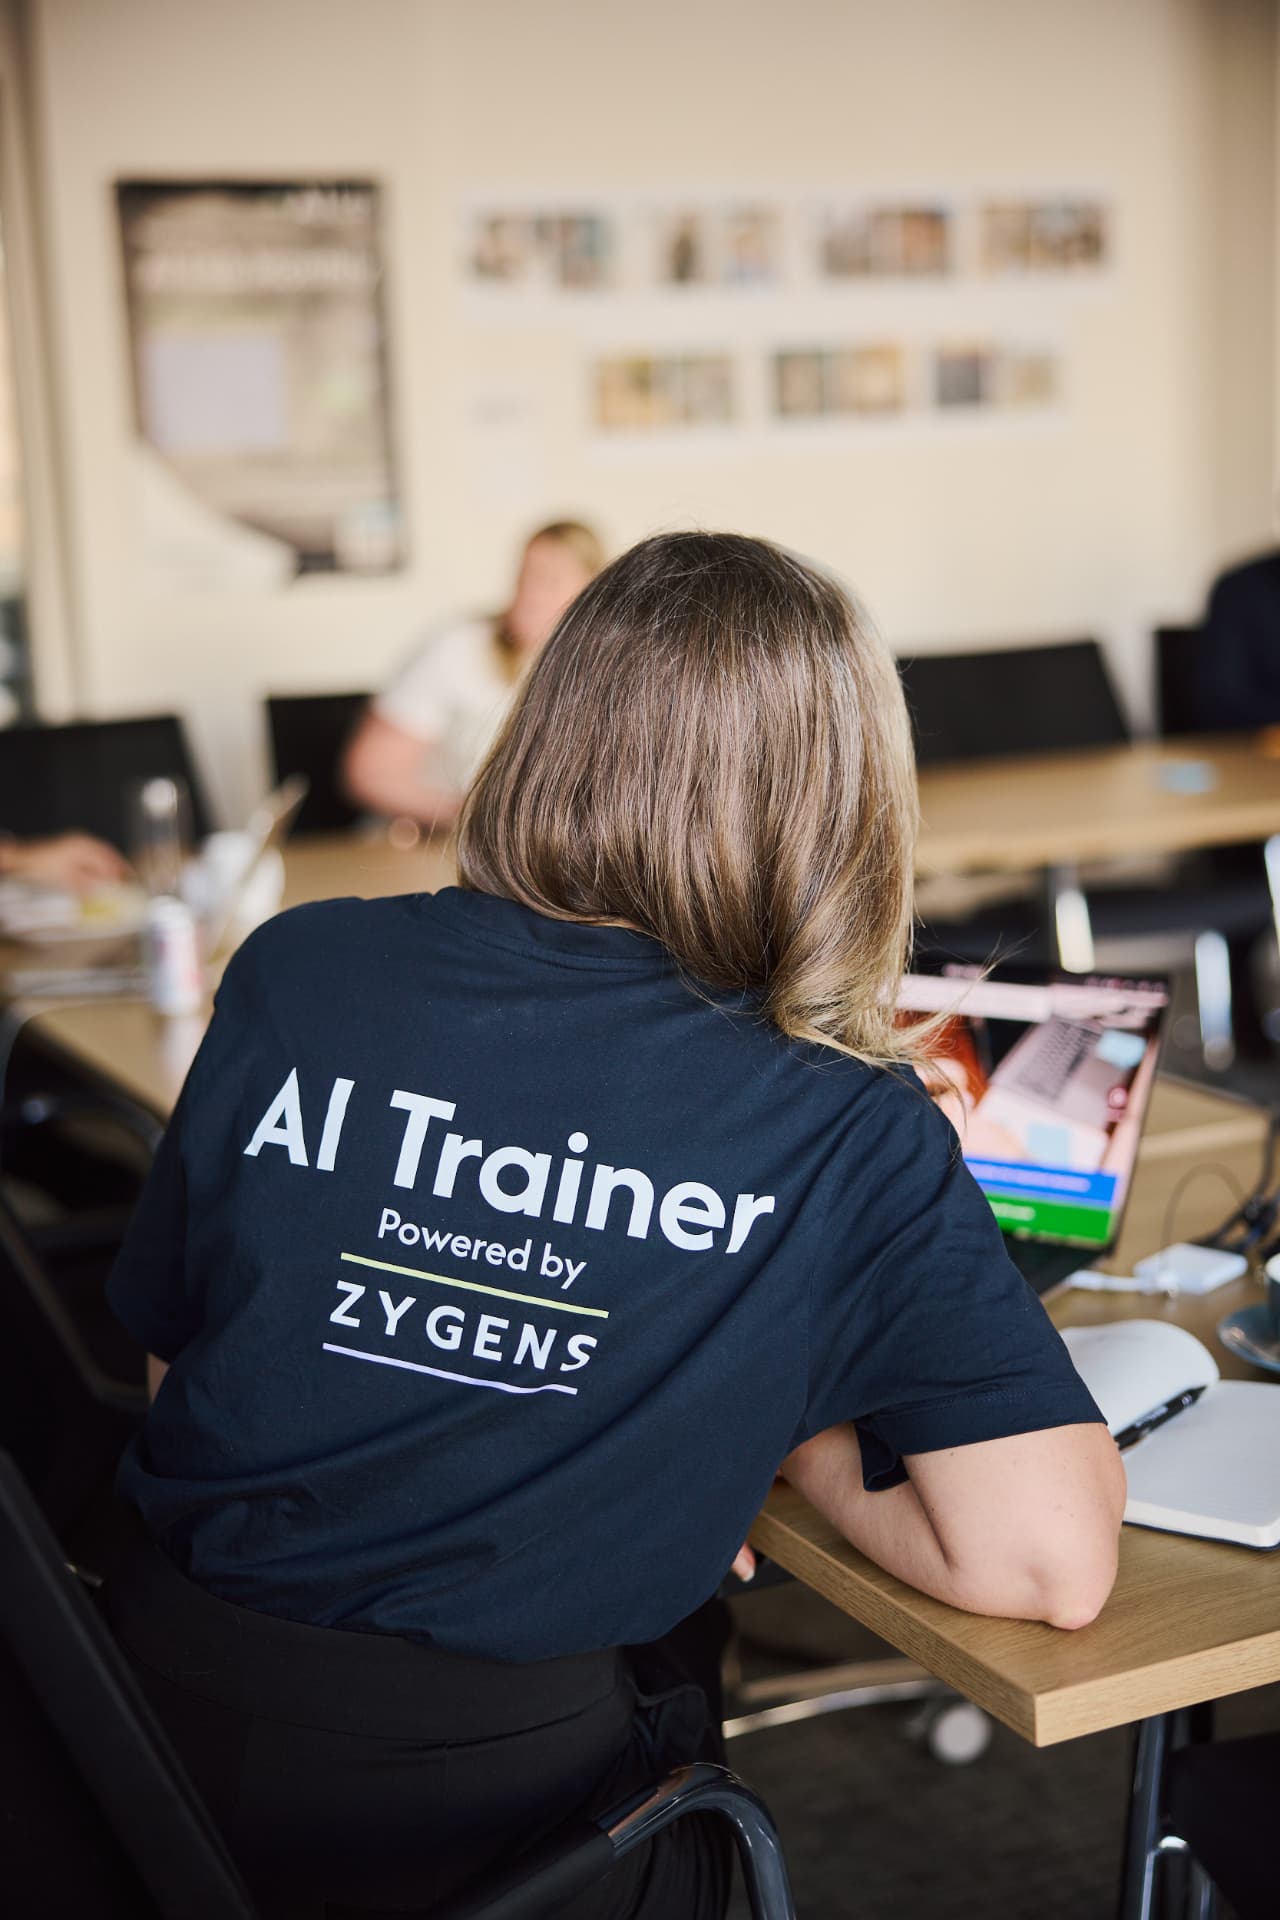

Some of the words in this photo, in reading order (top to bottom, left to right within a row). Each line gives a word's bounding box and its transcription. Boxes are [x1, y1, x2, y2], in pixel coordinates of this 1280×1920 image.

[244, 1067, 355, 1171] AI
[390, 1090, 775, 1253] Trainer
[378, 1208, 532, 1271] Powered
[540, 1243, 587, 1289] by
[330, 1280, 597, 1371] ZYGENS
